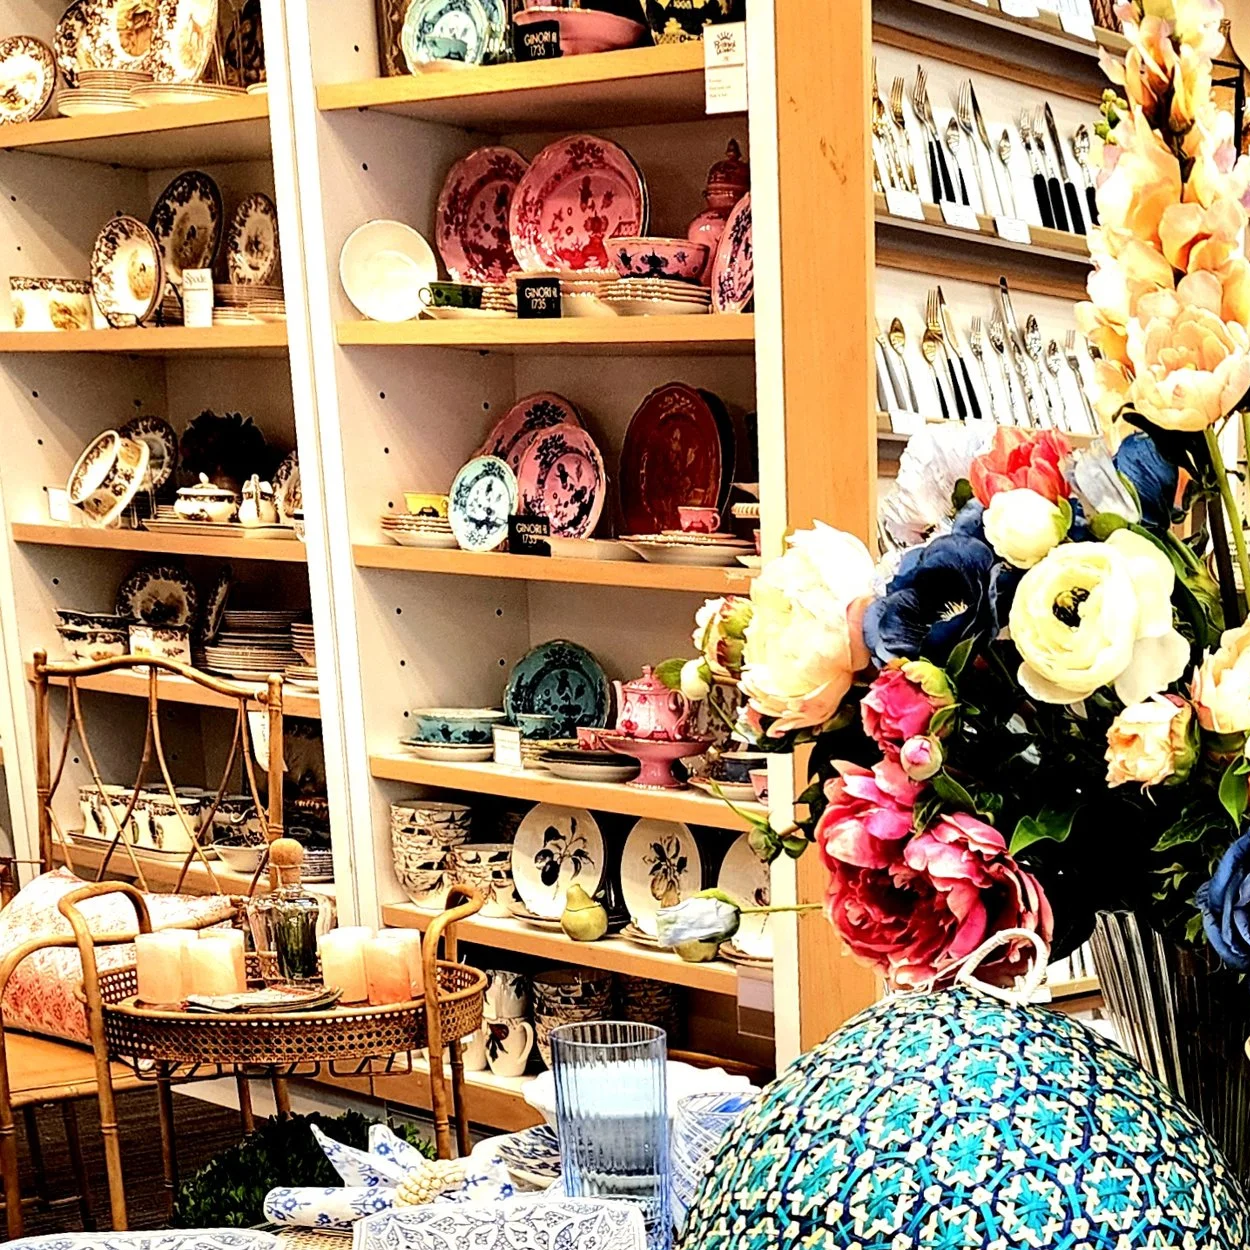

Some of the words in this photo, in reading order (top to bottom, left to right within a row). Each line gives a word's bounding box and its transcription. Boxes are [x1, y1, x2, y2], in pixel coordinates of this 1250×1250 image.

[523, 31, 551, 47] GINORI
[530, 43, 546, 57] 1735
[524, 286, 552, 299] GINORI
[531, 298, 547, 310] 1735
[515, 522, 542, 534] GINORI
[522, 533, 537, 545] 1735
